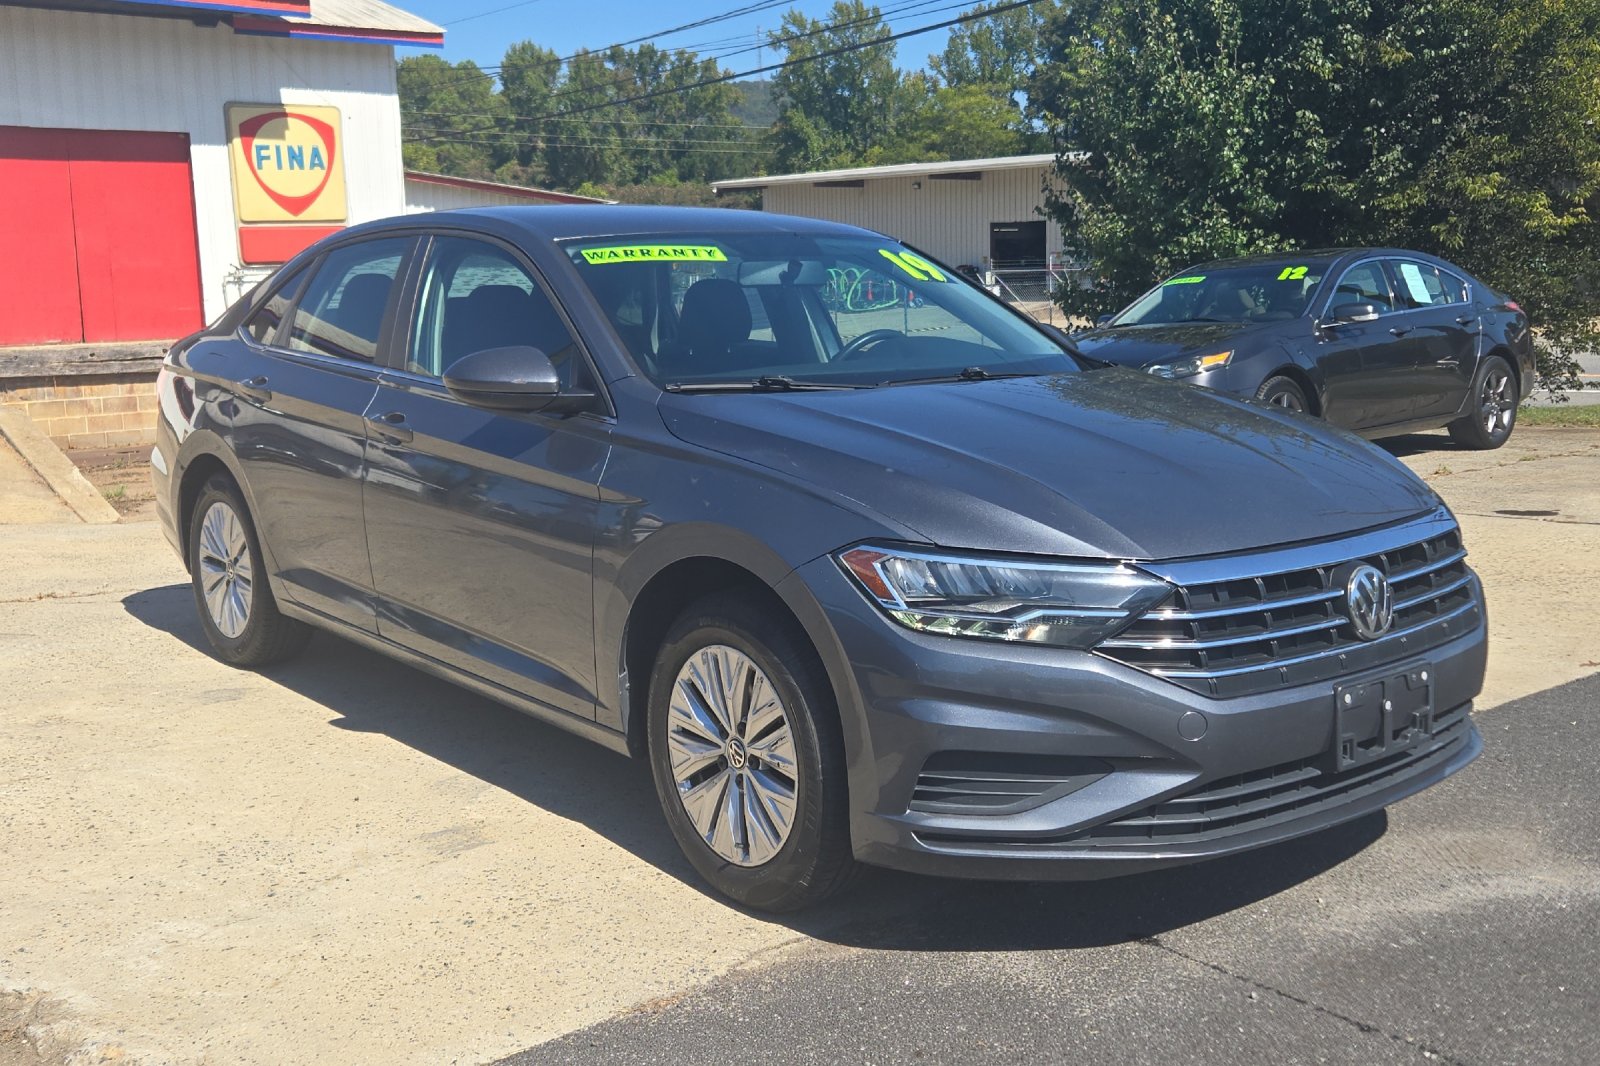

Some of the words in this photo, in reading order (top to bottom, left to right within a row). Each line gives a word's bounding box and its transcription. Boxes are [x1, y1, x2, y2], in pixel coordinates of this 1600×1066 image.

[255, 145, 325, 170] FINA
[586, 248, 716, 260] WARRANTY
[879, 249, 947, 282] 19
[1277, 266, 1309, 280] 12
